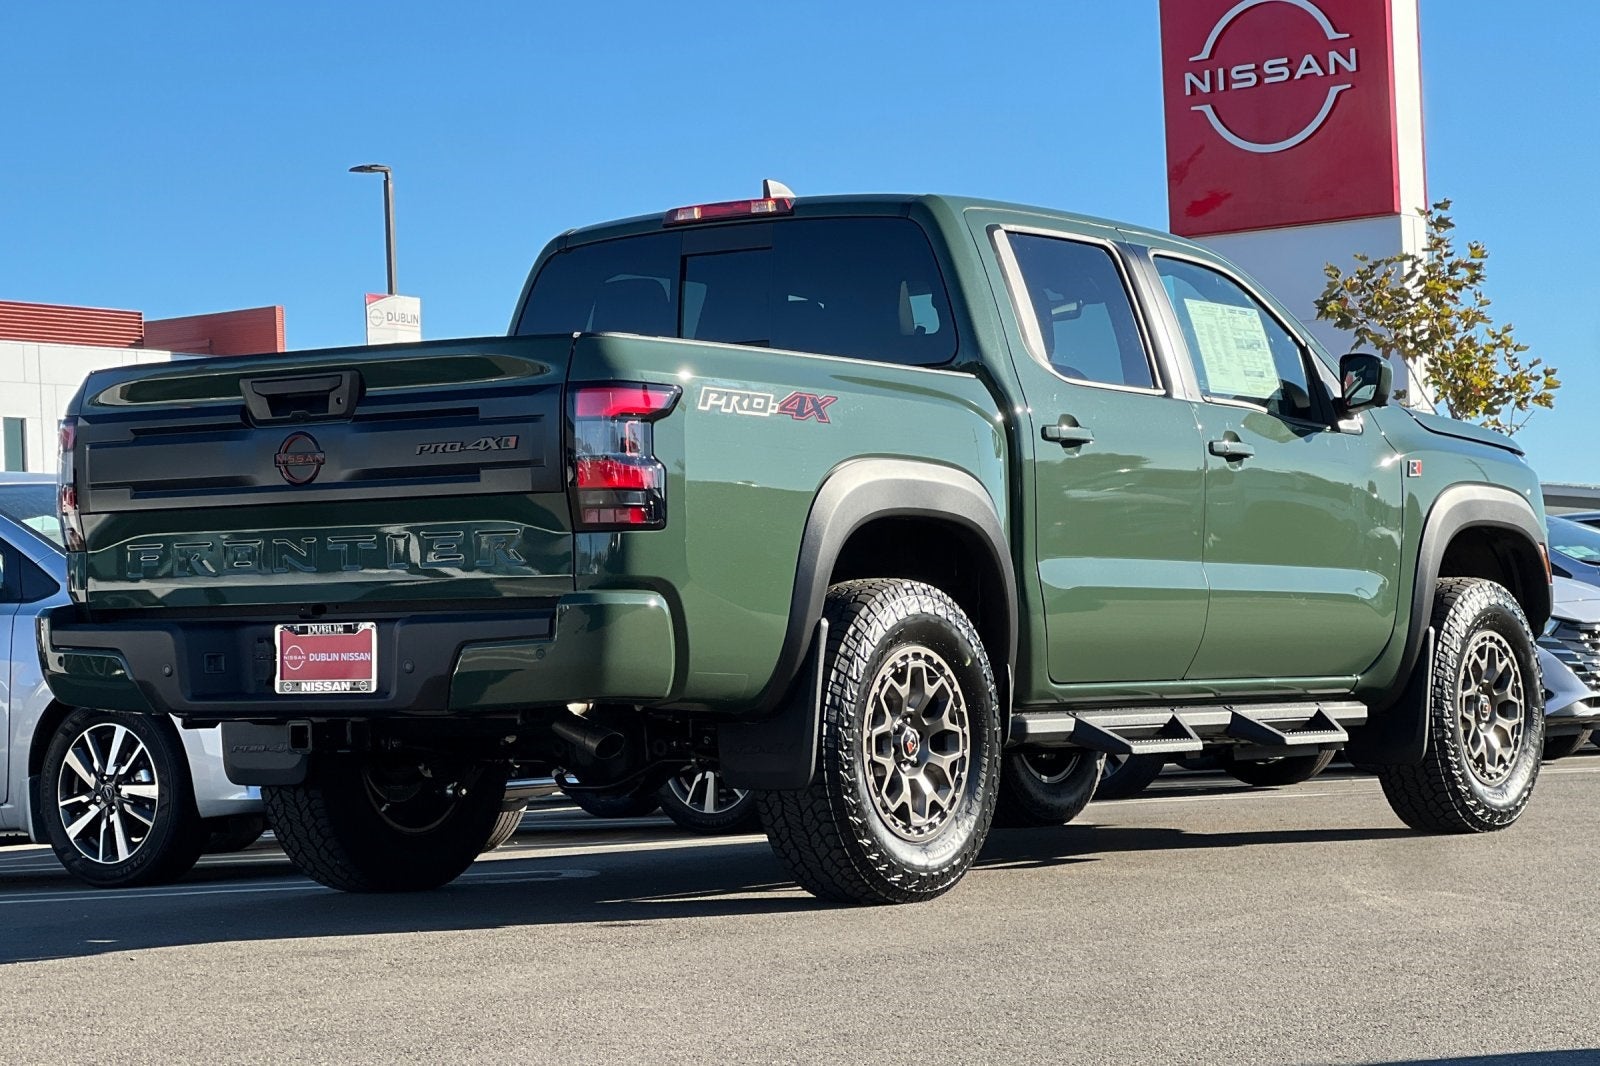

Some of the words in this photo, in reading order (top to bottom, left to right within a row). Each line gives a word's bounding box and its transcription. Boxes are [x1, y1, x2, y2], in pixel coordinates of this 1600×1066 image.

[1185, 47, 1357, 96] NISSAN
[386, 311, 419, 325] DUBLIN
[276, 453, 324, 465] NISSAN
[126, 528, 528, 579] FRONTIER
[307, 624, 344, 635] DUBLIN
[309, 652, 339, 662] DUBLIN
[340, 652, 371, 661] NISSAN
[301, 681, 350, 691] NISSAN
